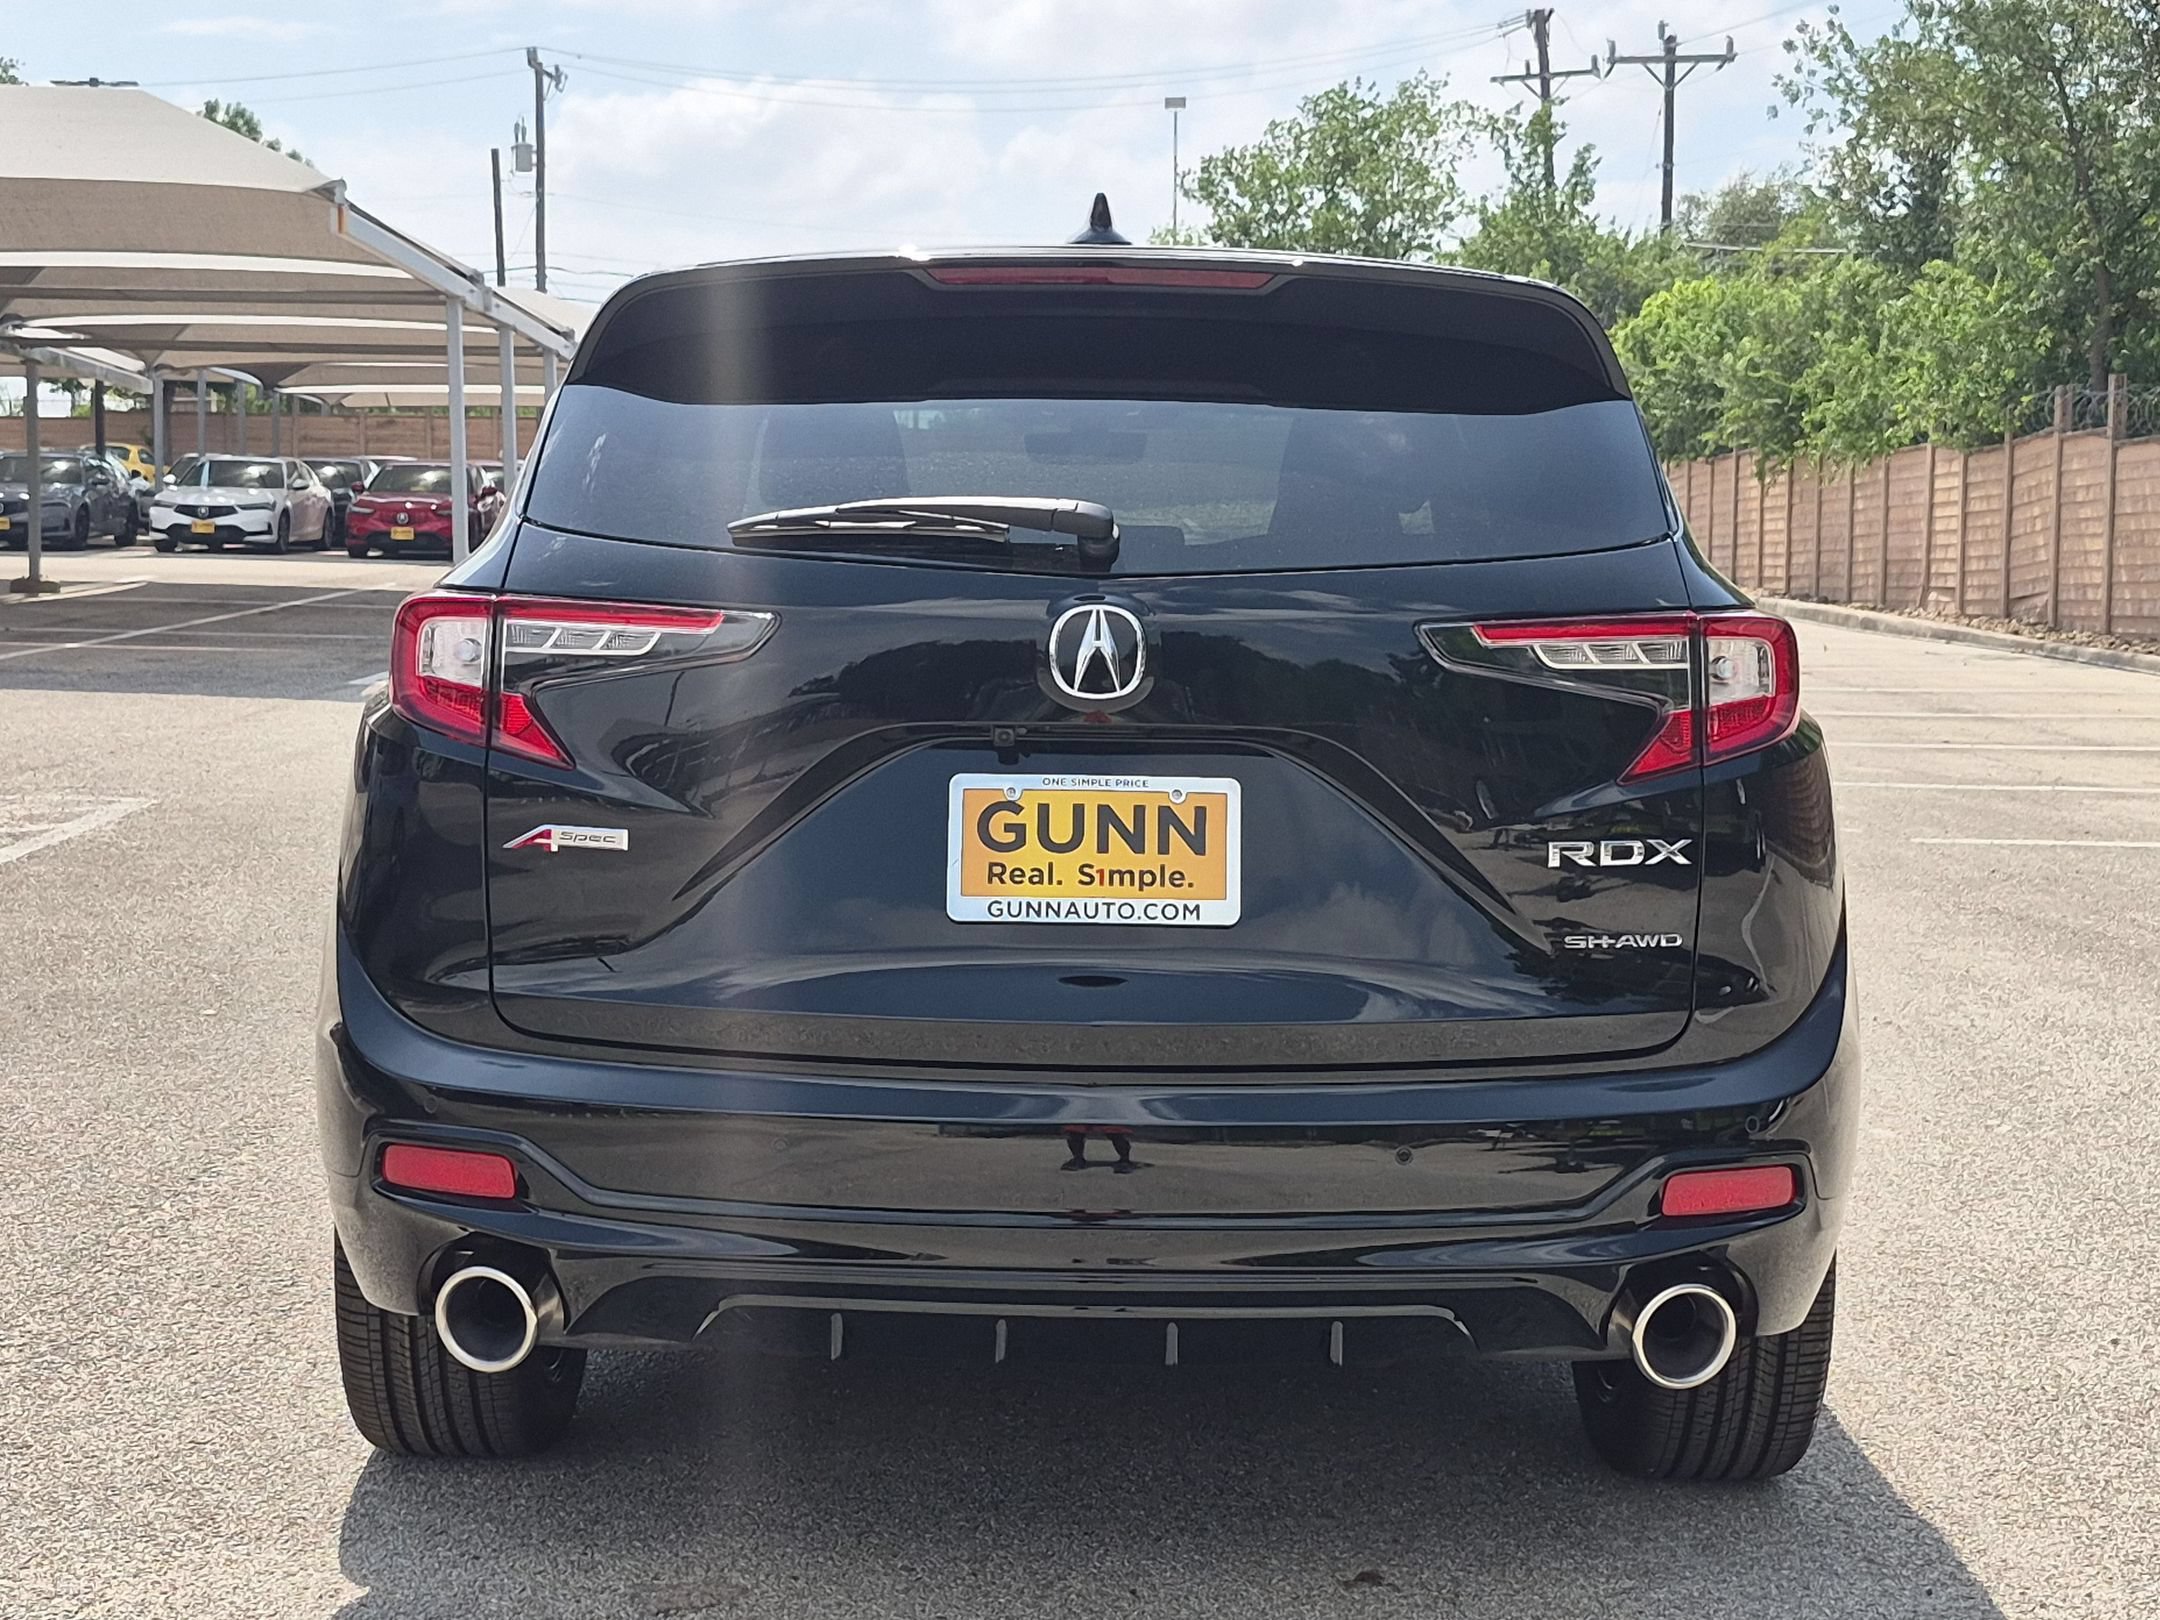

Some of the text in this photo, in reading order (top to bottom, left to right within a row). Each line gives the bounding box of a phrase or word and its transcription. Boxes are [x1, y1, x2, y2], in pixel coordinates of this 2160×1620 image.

[1042, 777, 1149, 788] ONE SIMPLE PRICE
[977, 800, 1206, 856] GUNN
[1547, 839, 1693, 868] RDX
[987, 862, 1062, 885] Real.
[987, 900, 1200, 921] GUNNAUTO.COM
